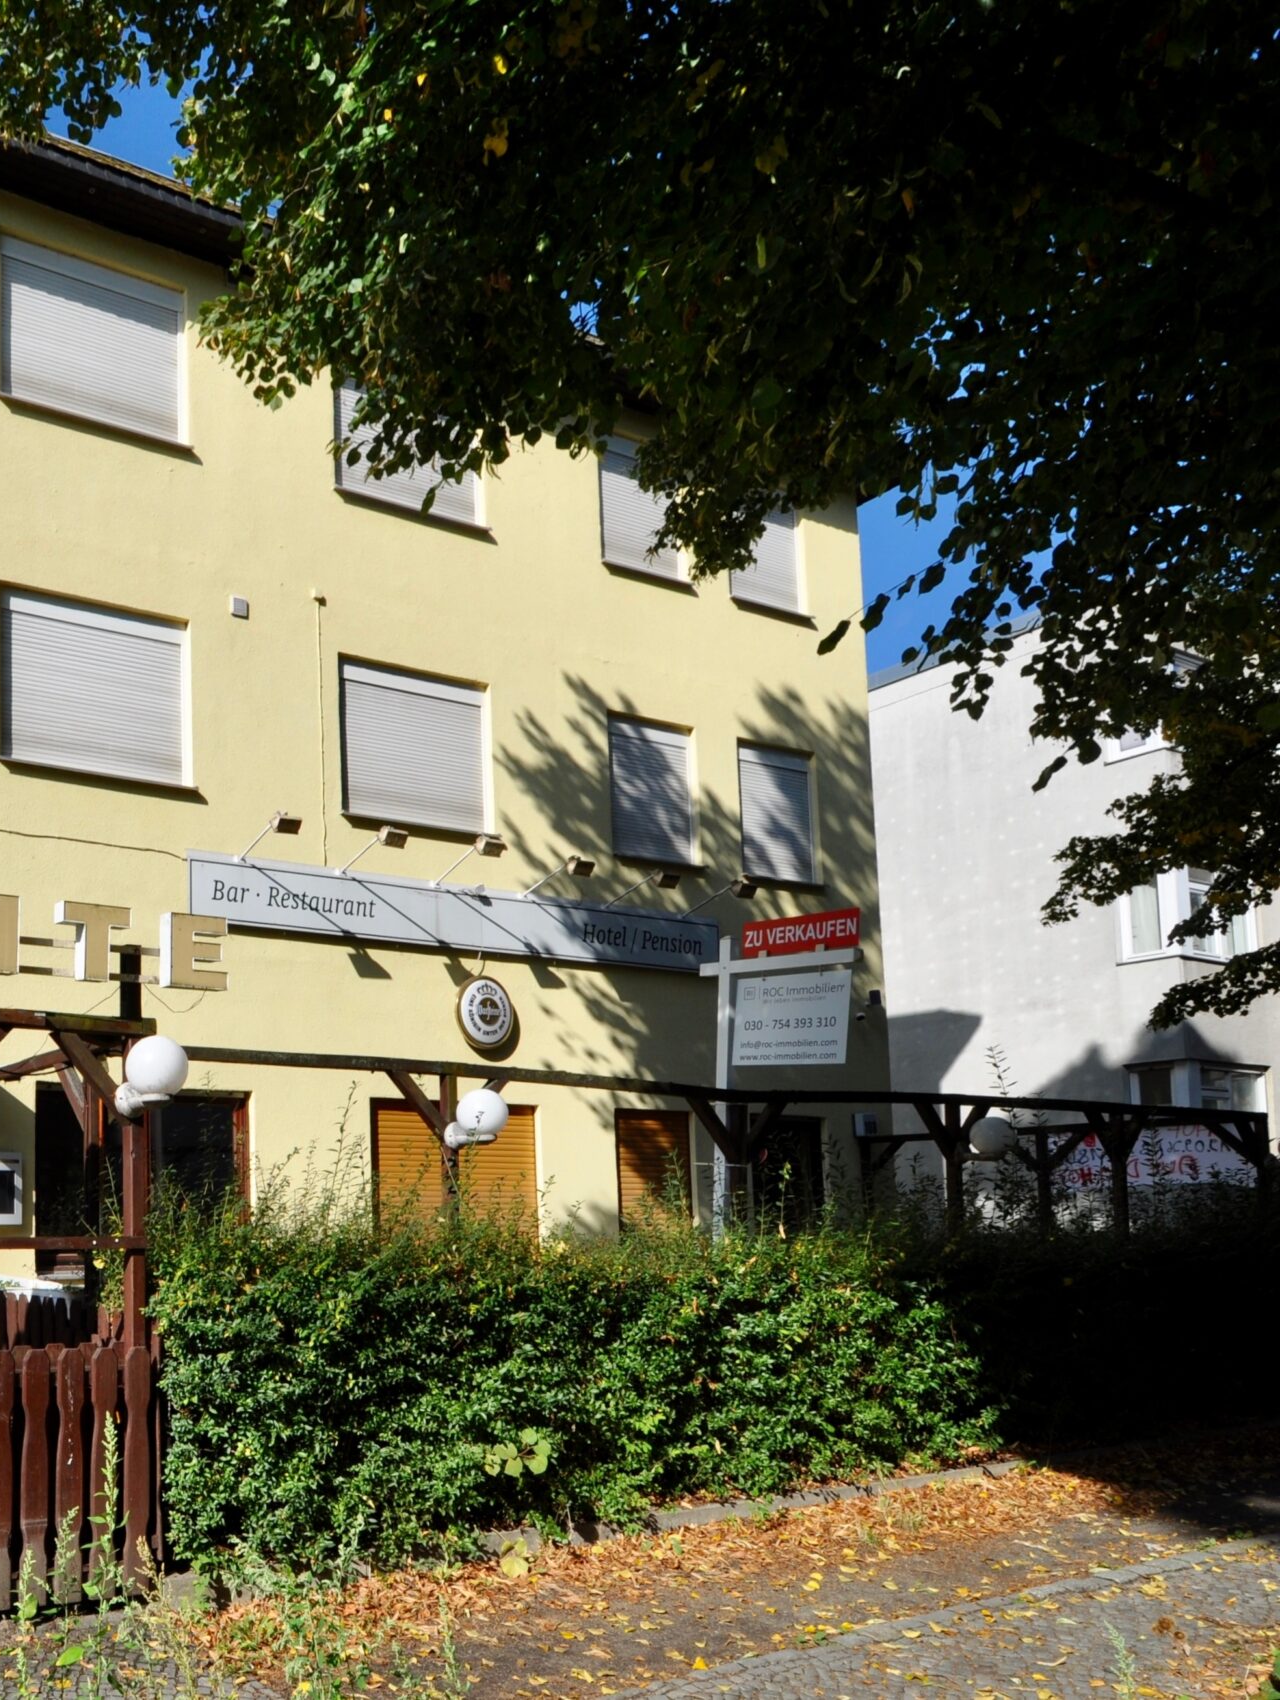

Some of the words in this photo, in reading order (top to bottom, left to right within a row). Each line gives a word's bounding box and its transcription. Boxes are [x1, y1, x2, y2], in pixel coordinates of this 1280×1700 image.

[211, 879, 250, 904] Bar
[267, 885, 377, 919] Restaurant
[582, 923, 627, 948] Hotel
[641, 930, 703, 956] Pension
[744, 929, 763, 948] ZU
[767, 917, 857, 944] VERKAUFEN
[762, 986, 784, 998] ROC
[744, 1020, 763, 1031] 030
[771, 1019, 791, 1030] 754
[793, 1017, 813, 1029] 393
[815, 1016, 837, 1028] 310
[740, 1039, 838, 1049] info@roc-immobilien.com
[739, 1051, 837, 1062] www.roc-immobilien.com
